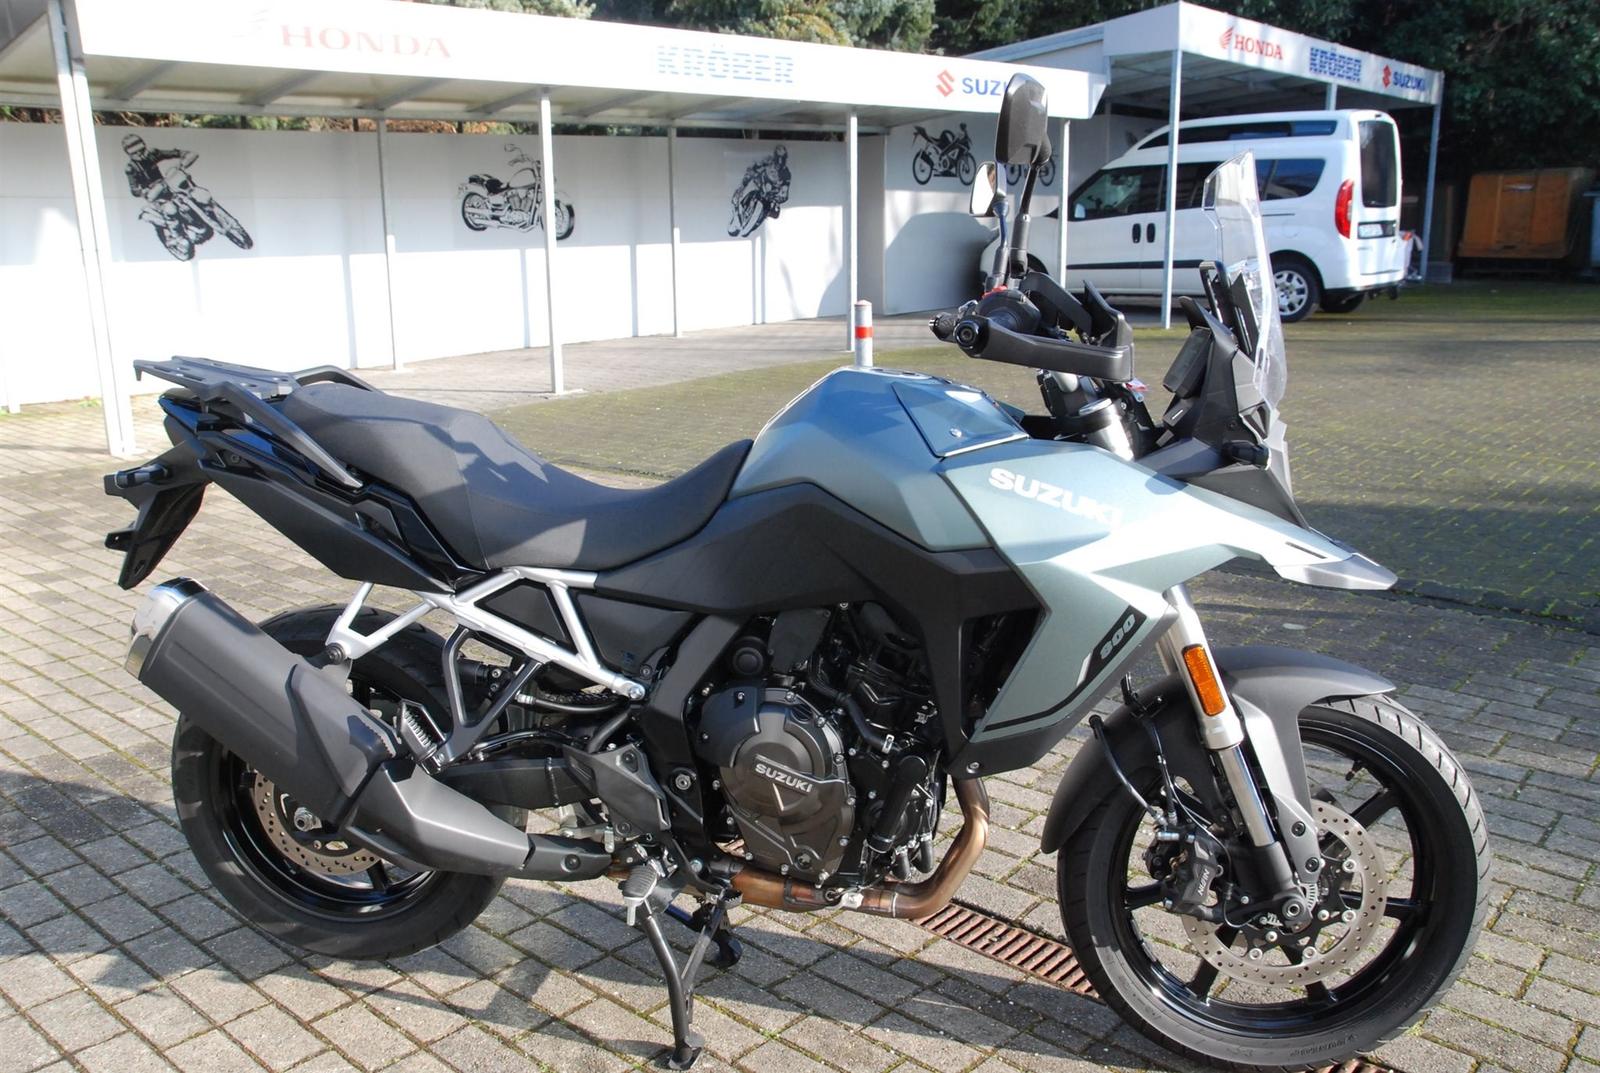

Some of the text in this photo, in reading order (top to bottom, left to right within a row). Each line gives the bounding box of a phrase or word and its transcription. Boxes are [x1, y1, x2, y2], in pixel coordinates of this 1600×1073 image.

[281, 24, 451, 58] HONDA
[1234, 33, 1284, 61] HONDA
[657, 42, 794, 84] KRÖBER
[962, 76, 1008, 97] SUZ
[1393, 71, 1427, 92] SUZUKI
[988, 467, 1123, 532] SUZUKI
[1100, 612, 1136, 660] 800
[755, 762, 813, 793] SUZUKI
